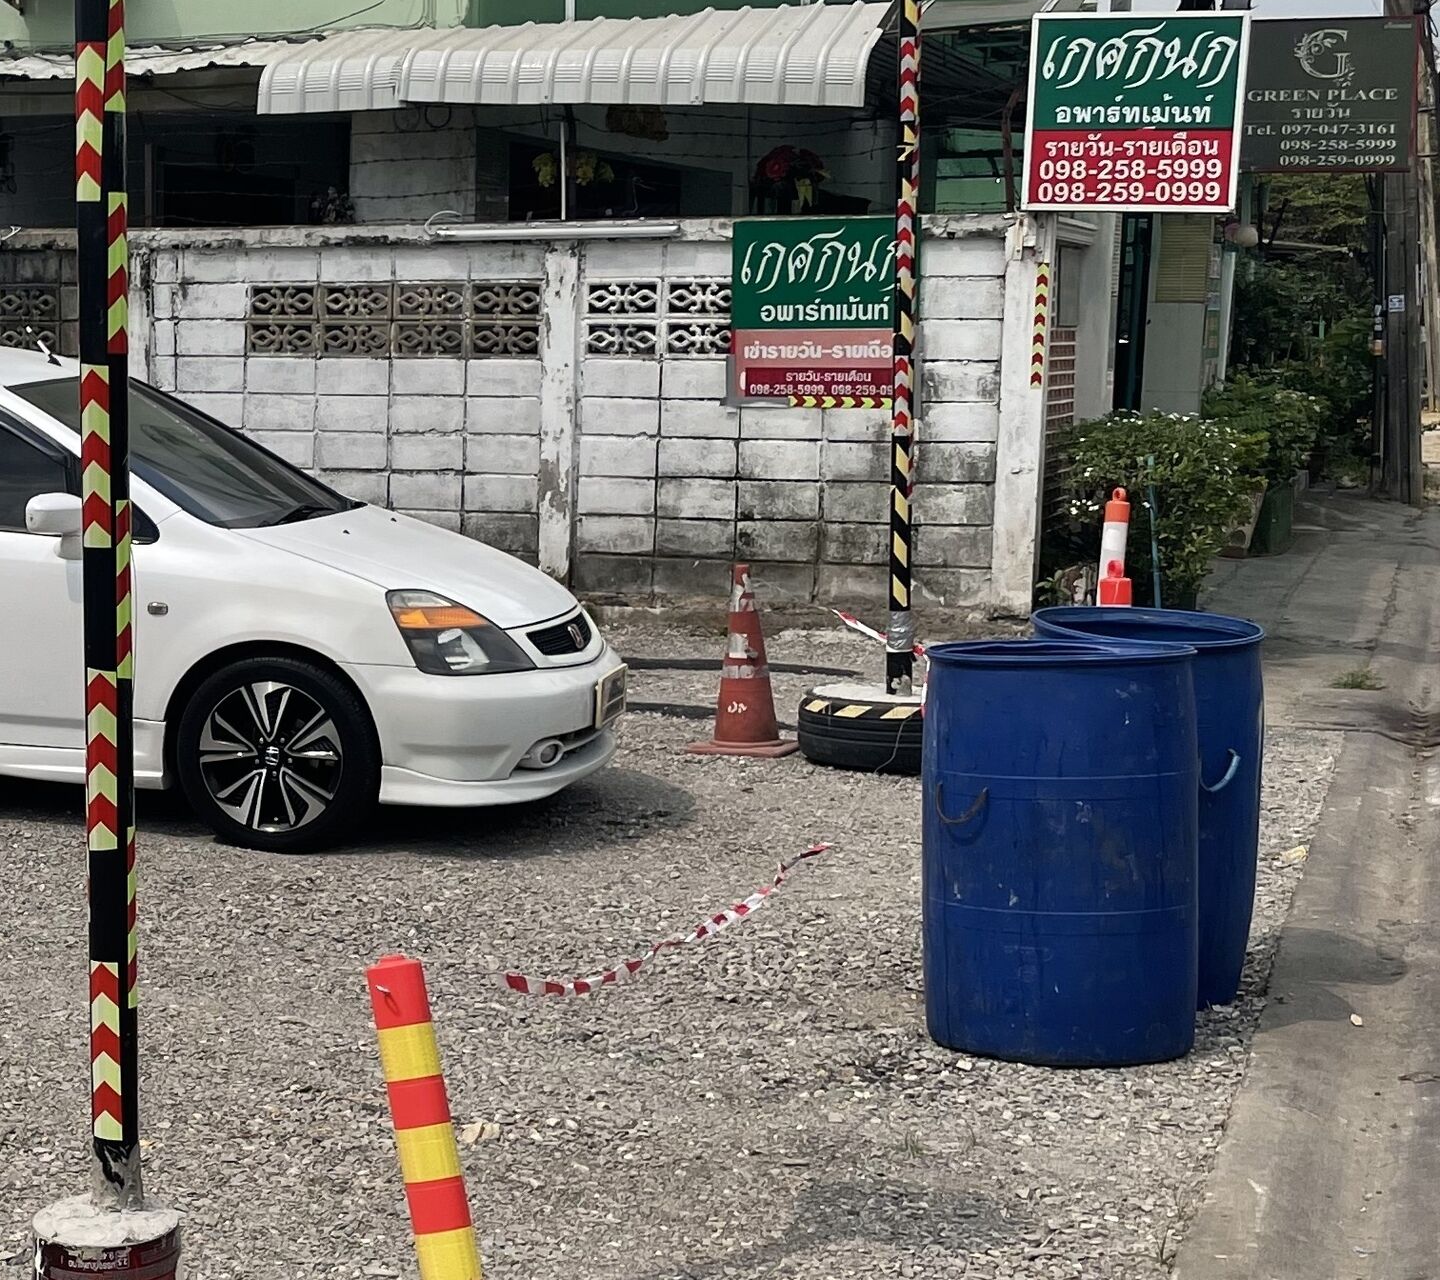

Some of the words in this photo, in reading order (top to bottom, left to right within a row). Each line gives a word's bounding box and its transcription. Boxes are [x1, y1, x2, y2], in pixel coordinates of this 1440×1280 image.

[1042, 21, 1238, 89] เกศกนก
[1247, 88, 1320, 102] GREEN
[1327, 88, 1398, 101] PLACE
[1054, 93, 1214, 123] อพาร์ทเม้นท์
[1291, 102, 1351, 119] รายวัน
[1245, 124, 1276, 136] Tel.
[1281, 124, 1396, 136] 097-047-3161
[1045, 131, 1219, 157] รายวัน-รายเดือน
[1280, 139, 1397, 151] 098-258-5999
[1039, 158, 1223, 180] 098-258-5999
[1279, 155, 1396, 166] 098-259-0999
[1037, 181, 1221, 203] 098-259-0999
[759, 295, 891, 322] อพาร์ทเม้นท์
[743, 339, 893, 359] เช่ารายวัน-รายเดือ
[831, 384, 893, 396] 098-259-09
